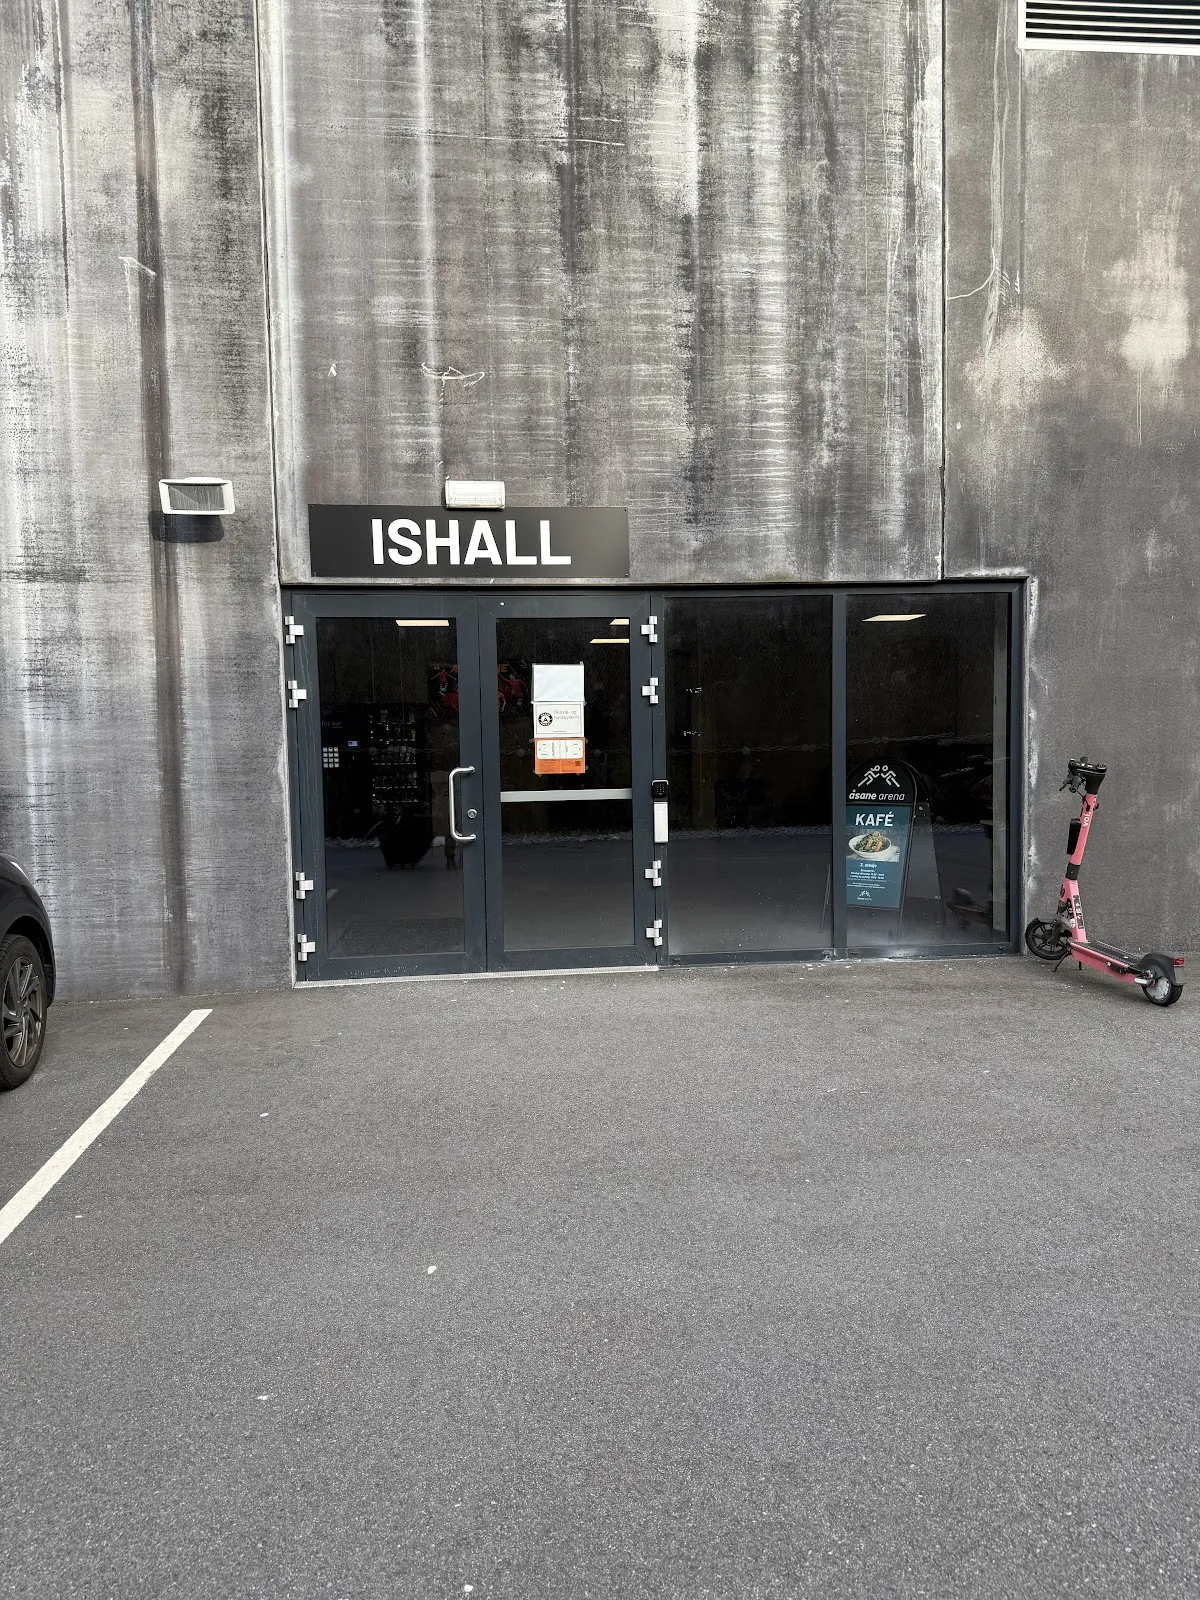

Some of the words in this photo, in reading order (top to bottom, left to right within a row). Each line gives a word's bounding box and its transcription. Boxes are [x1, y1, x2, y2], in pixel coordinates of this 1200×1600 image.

[371, 518, 572, 565] ISHALL
[849, 789, 877, 800] åsane
[878, 793, 905, 801] arena
[855, 811, 894, 827] KAFÉ
